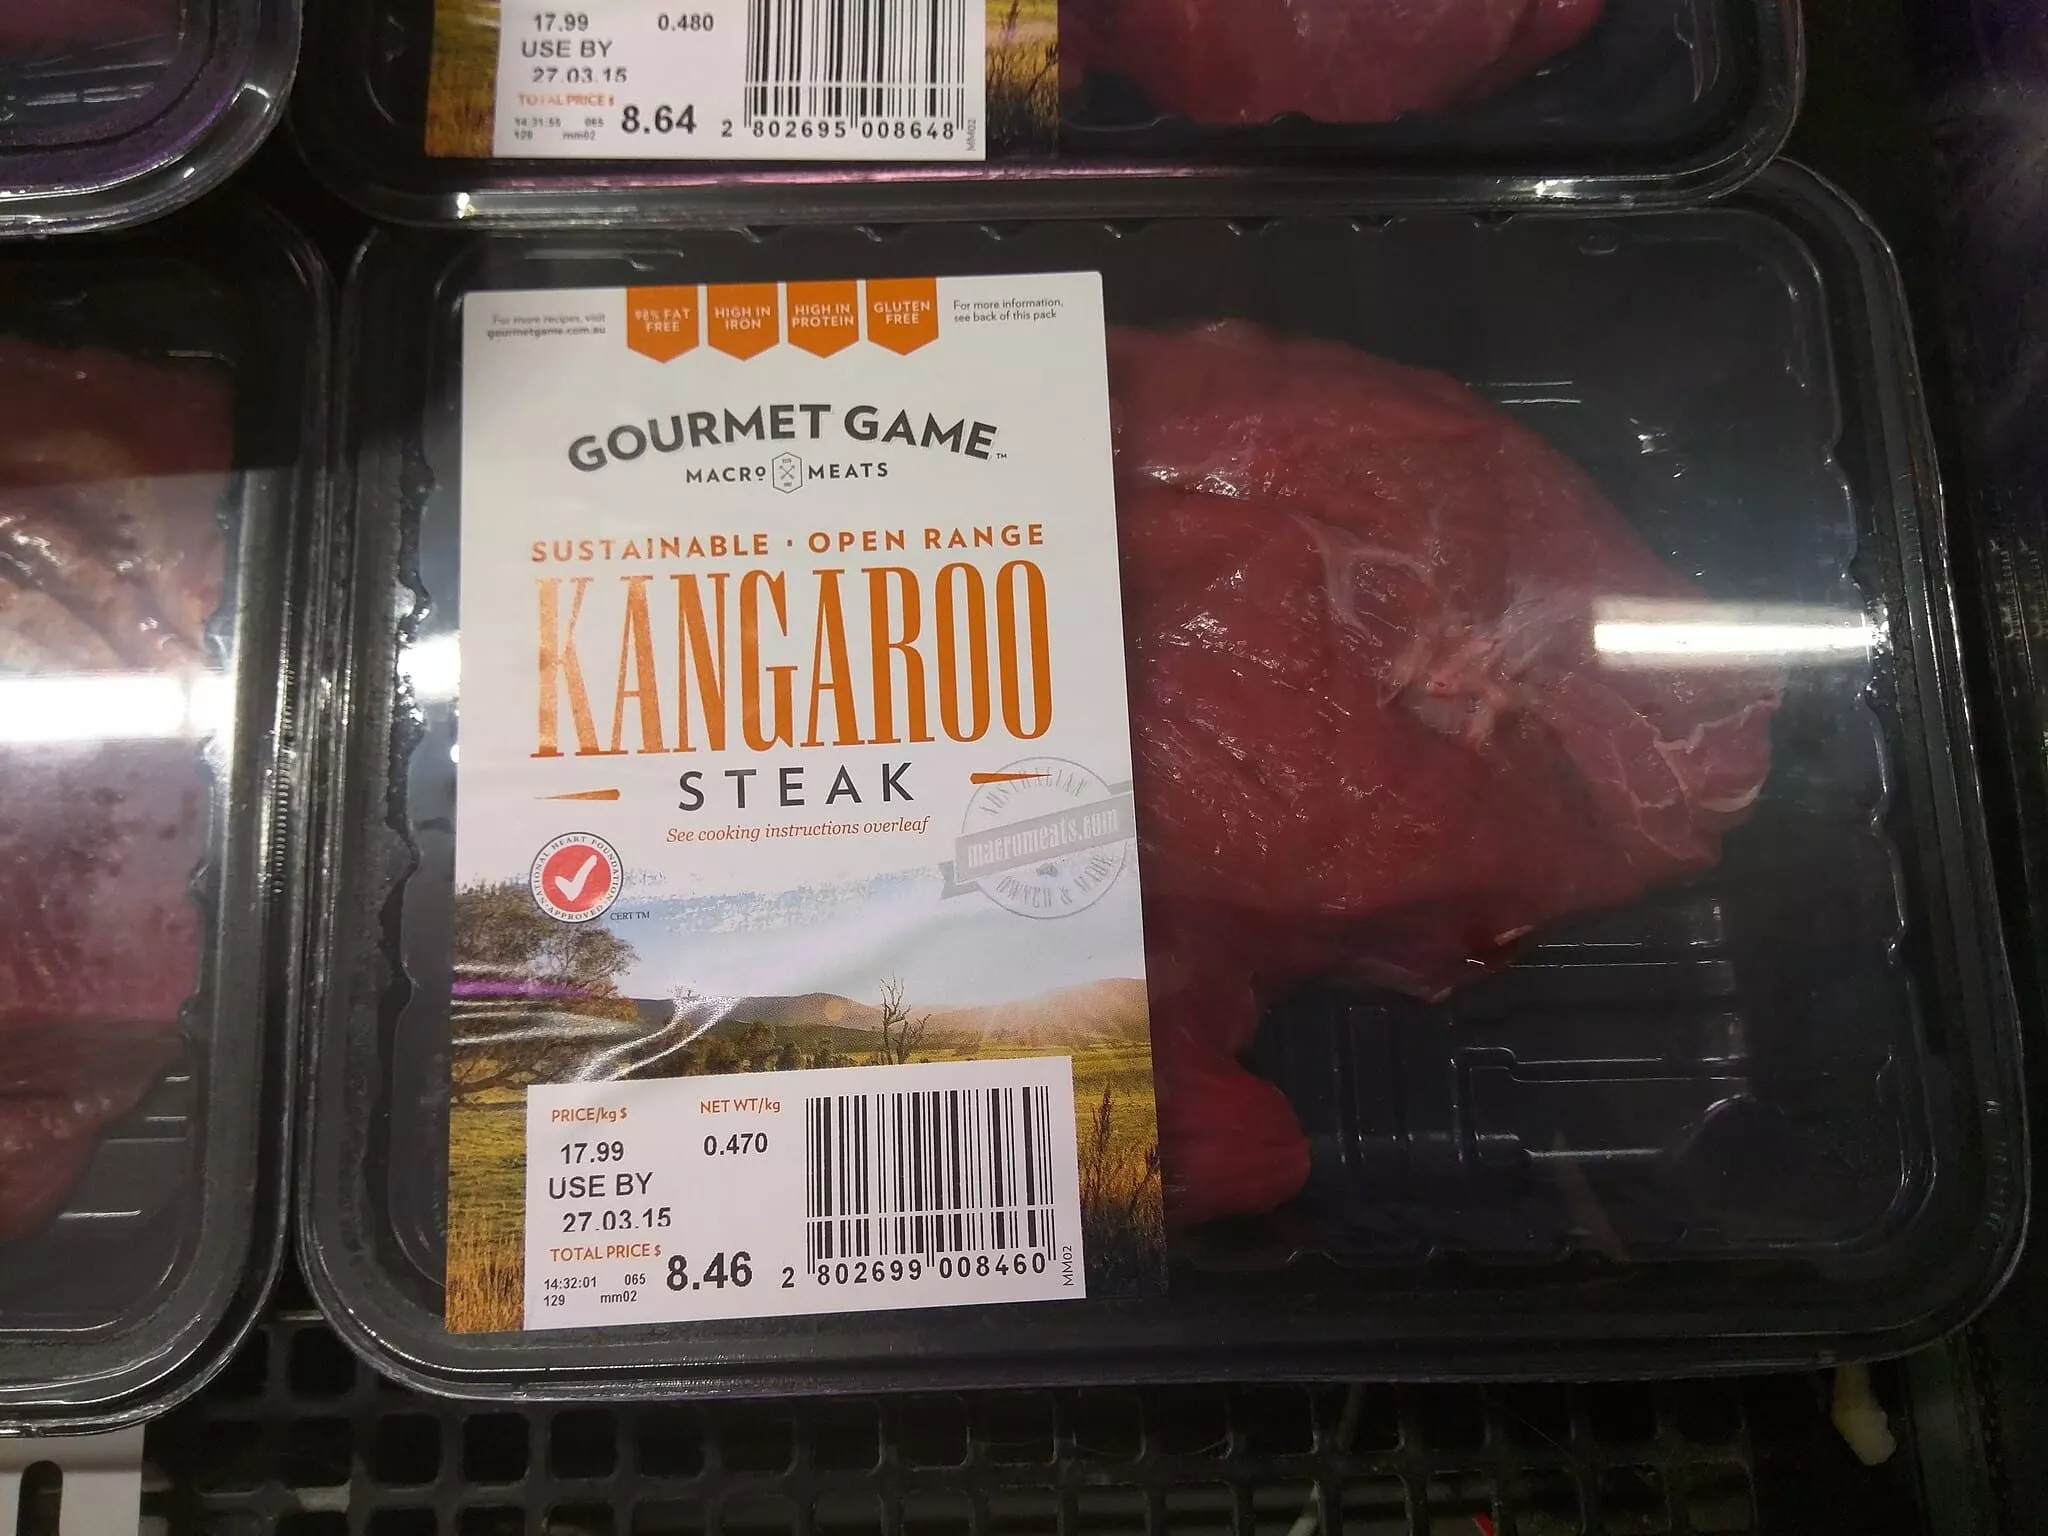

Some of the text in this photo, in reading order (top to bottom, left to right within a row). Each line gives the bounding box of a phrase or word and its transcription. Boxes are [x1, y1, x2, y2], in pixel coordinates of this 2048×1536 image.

[533, 12, 590, 32] 17.99
[657, 13, 714, 32] 0.480
[521, 39, 613, 58] USE BY
[532, 65, 628, 83] 27.03.15
[518, 94, 564, 107] TOTAL
[566, 94, 603, 106] PRICE
[621, 104, 697, 135] 8.64
[721, 120, 955, 140] 2 802695 008648
[714, 306, 772, 318] HIGH IN
[795, 303, 851, 316] HIGH IN
[873, 300, 931, 313] GLUTEN
[953, 298, 1064, 311] For more information,
[663, 307, 691, 321] FAT
[791, 315, 855, 329] PROTEIN
[885, 313, 920, 325] FREE
[954, 308, 1058, 323] see back of this pack
[646, 320, 681, 333] FREE
[725, 318, 762, 331] IRON
[568, 403, 831, 472] GOURMET
[843, 405, 998, 460] GAME
[808, 462, 889, 480] MEATS
[531, 523, 1044, 563] SUSTAINABLE OPEN RANGE
[530, 559, 1053, 758] KANGAROO
[678, 762, 915, 812] STEAK
[666, 816, 931, 843] See cooking instructions overleaf
[610, 912, 634, 921] CERT
[551, 1106, 628, 1124] PRICE/kg $
[699, 1098, 781, 1114] NET WT/kg
[560, 1141, 624, 1165] 17.99
[703, 1132, 768, 1156] 0.470
[549, 1172, 653, 1200] USE BY
[562, 1207, 672, 1233] 27.03.15
[550, 1243, 662, 1263] TOTAL PRICE $
[666, 1251, 753, 1292] 8.46
[781, 1252, 1046, 1289] 2 802699 008460
[1063, 1244, 1075, 1287] MM02
[543, 1276, 597, 1291] 14:32:01
[624, 1273, 647, 1286] 065
[543, 1295, 566, 1307] 129
[600, 1290, 638, 1304] mm02
